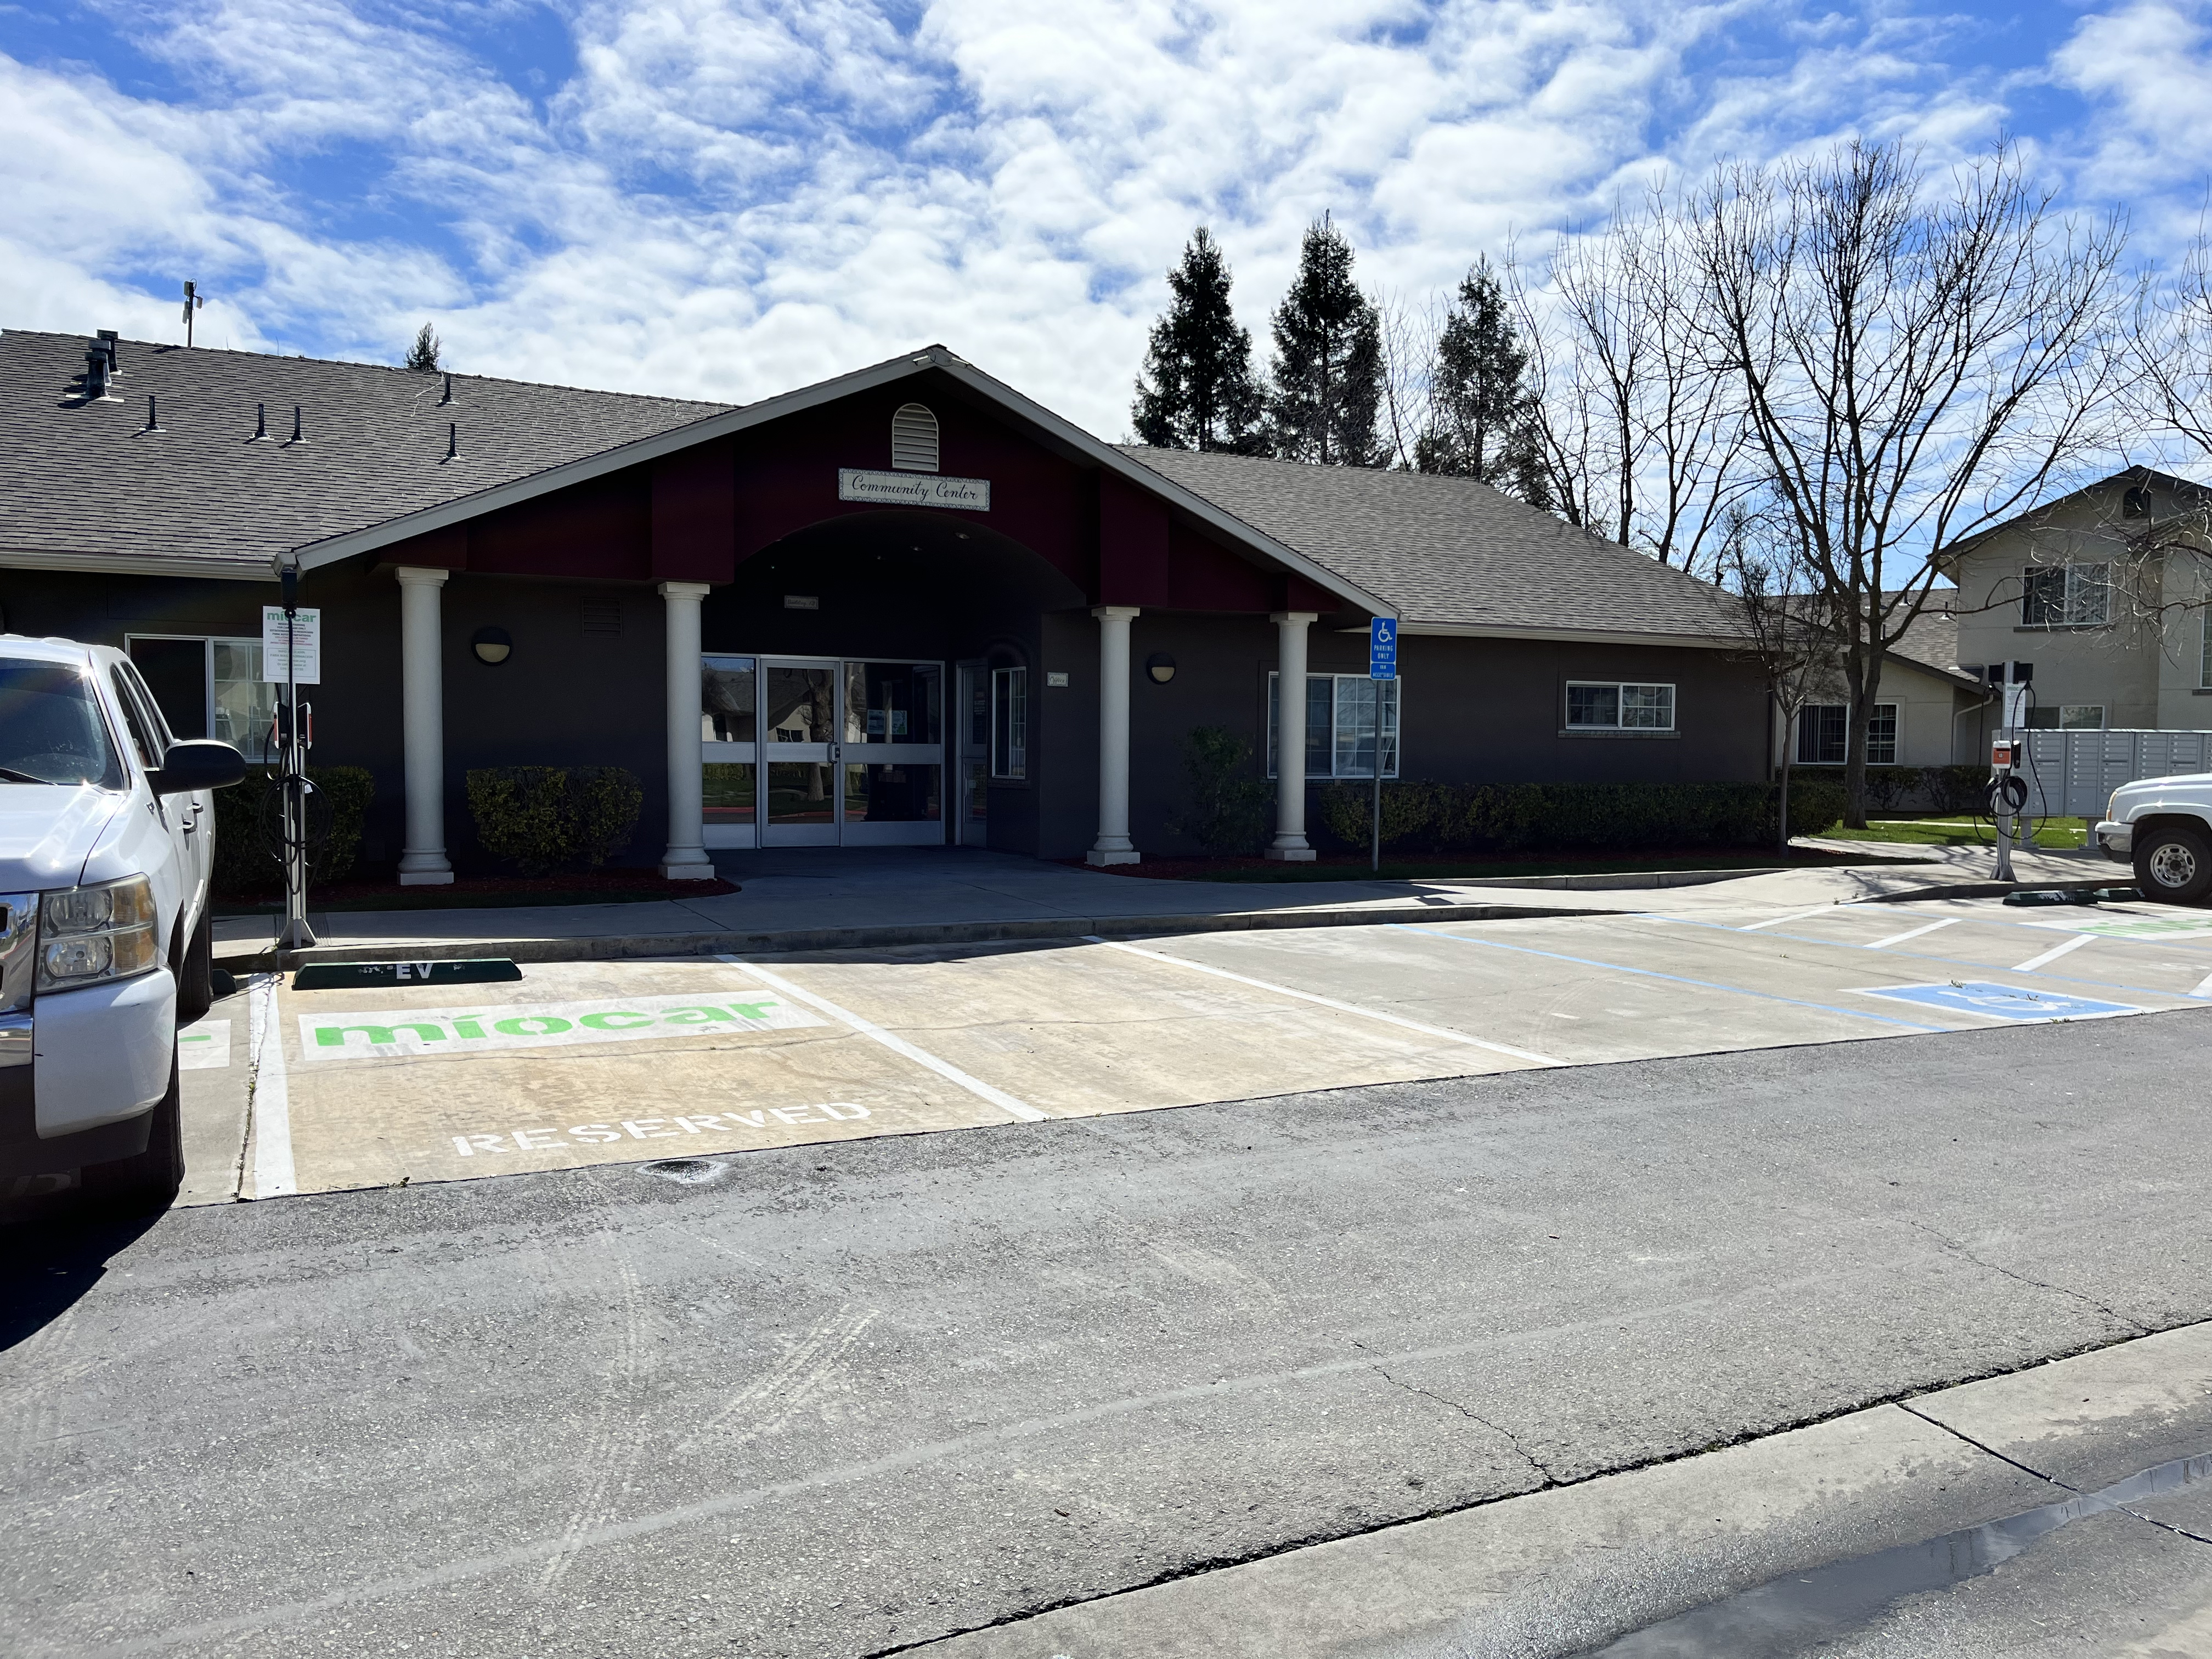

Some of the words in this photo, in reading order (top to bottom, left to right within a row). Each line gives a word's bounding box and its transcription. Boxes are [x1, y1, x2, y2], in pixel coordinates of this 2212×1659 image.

[851, 475, 930, 501] Community
[935, 481, 978, 500] Center
[1049, 675, 1065, 685] Office
[396, 963, 433, 979] EV
[452, 1102, 872, 1156] RESERVED
